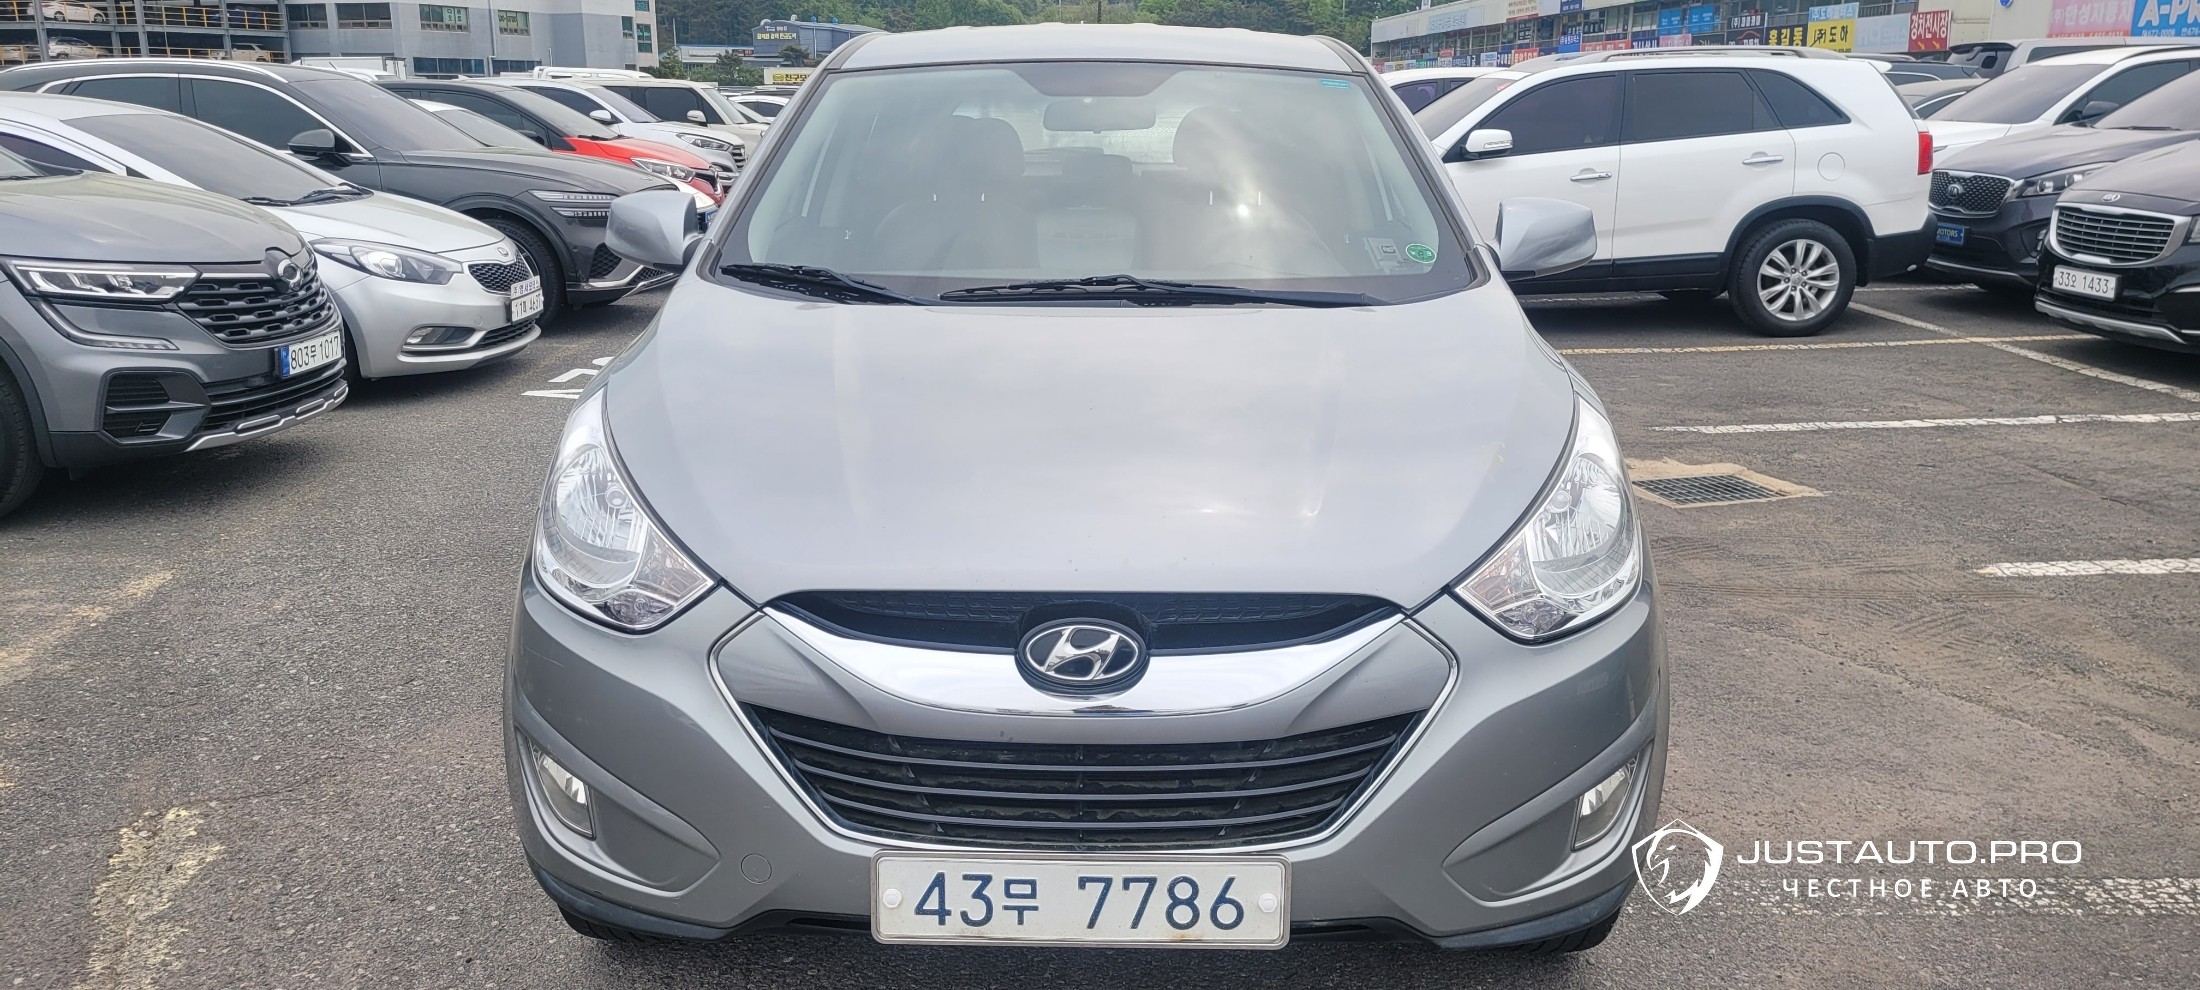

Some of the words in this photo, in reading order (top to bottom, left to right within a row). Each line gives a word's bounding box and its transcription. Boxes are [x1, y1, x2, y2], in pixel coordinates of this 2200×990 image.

[2058, 271, 2077, 288] 33오
[2082, 274, 2110, 294] 1433
[290, 344, 317, 370] 803무
[319, 335, 339, 361] 1017
[913, 871, 1040, 928] 43무
[1077, 875, 1246, 931] 7786
